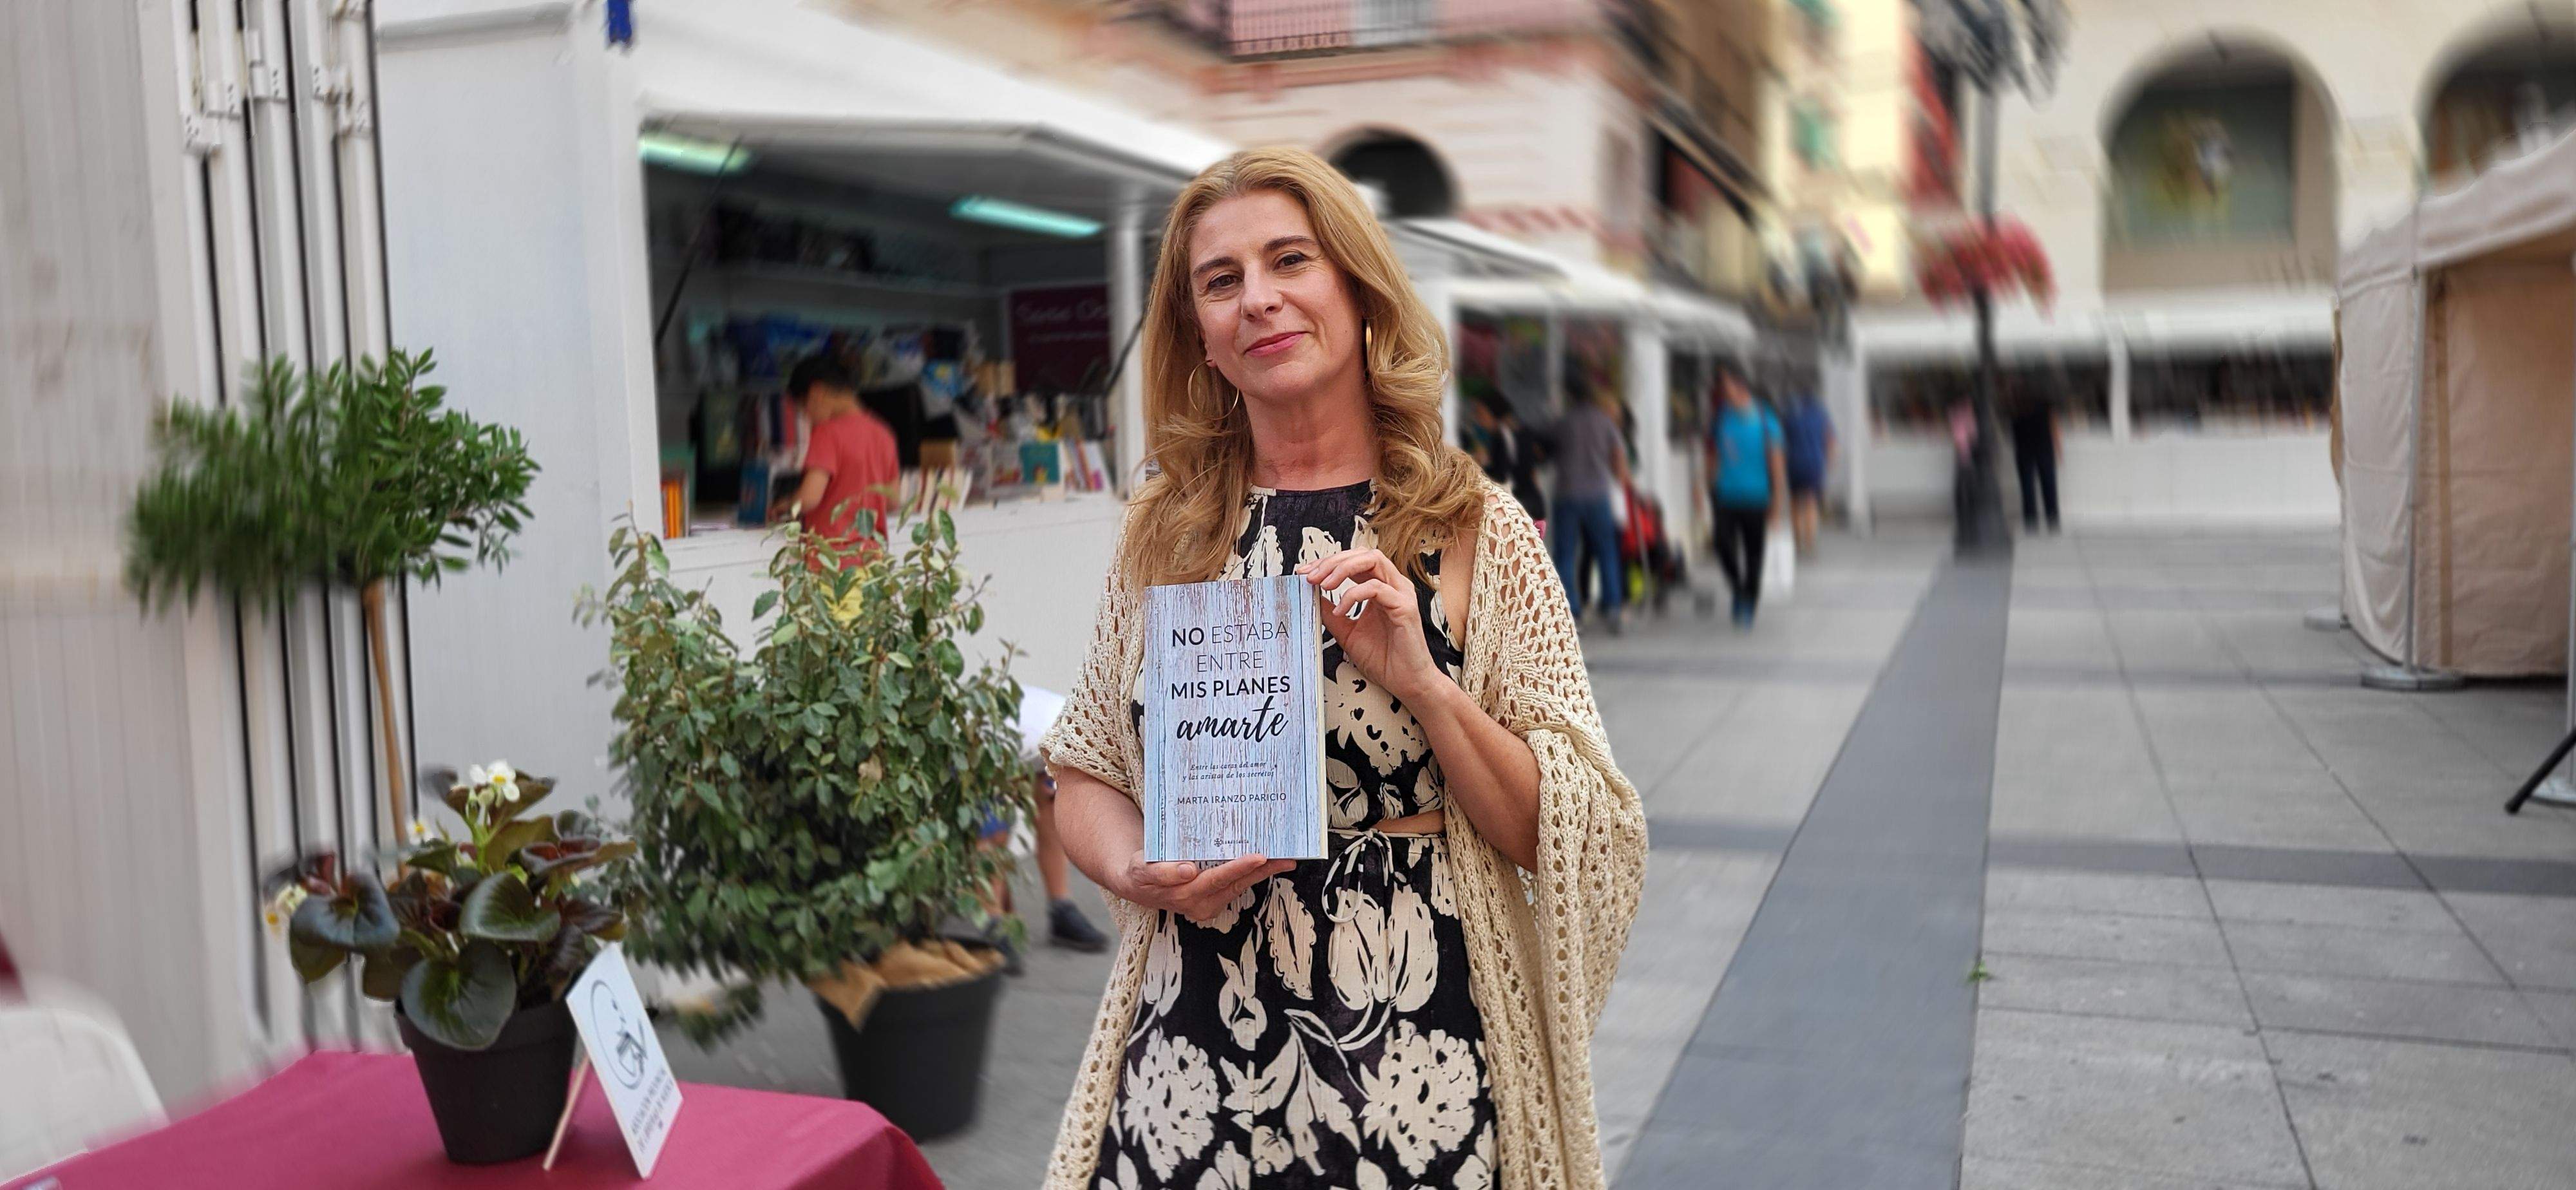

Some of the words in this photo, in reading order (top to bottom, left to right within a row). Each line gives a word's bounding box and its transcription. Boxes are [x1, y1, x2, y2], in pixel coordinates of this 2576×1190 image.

[1172, 627, 1204, 648] NO
[1211, 621, 1289, 644] ESTABA
[1197, 650, 1264, 672] ENTRE
[1171, 680, 1207, 700] MIS
[1213, 675, 1291, 697] PLANES
[1177, 695, 1289, 742] amarte
[1177, 797, 1209, 805] MARTA
[1211, 795, 1246, 804] IRANZO
[1249, 793, 1287, 802] PARICIO
